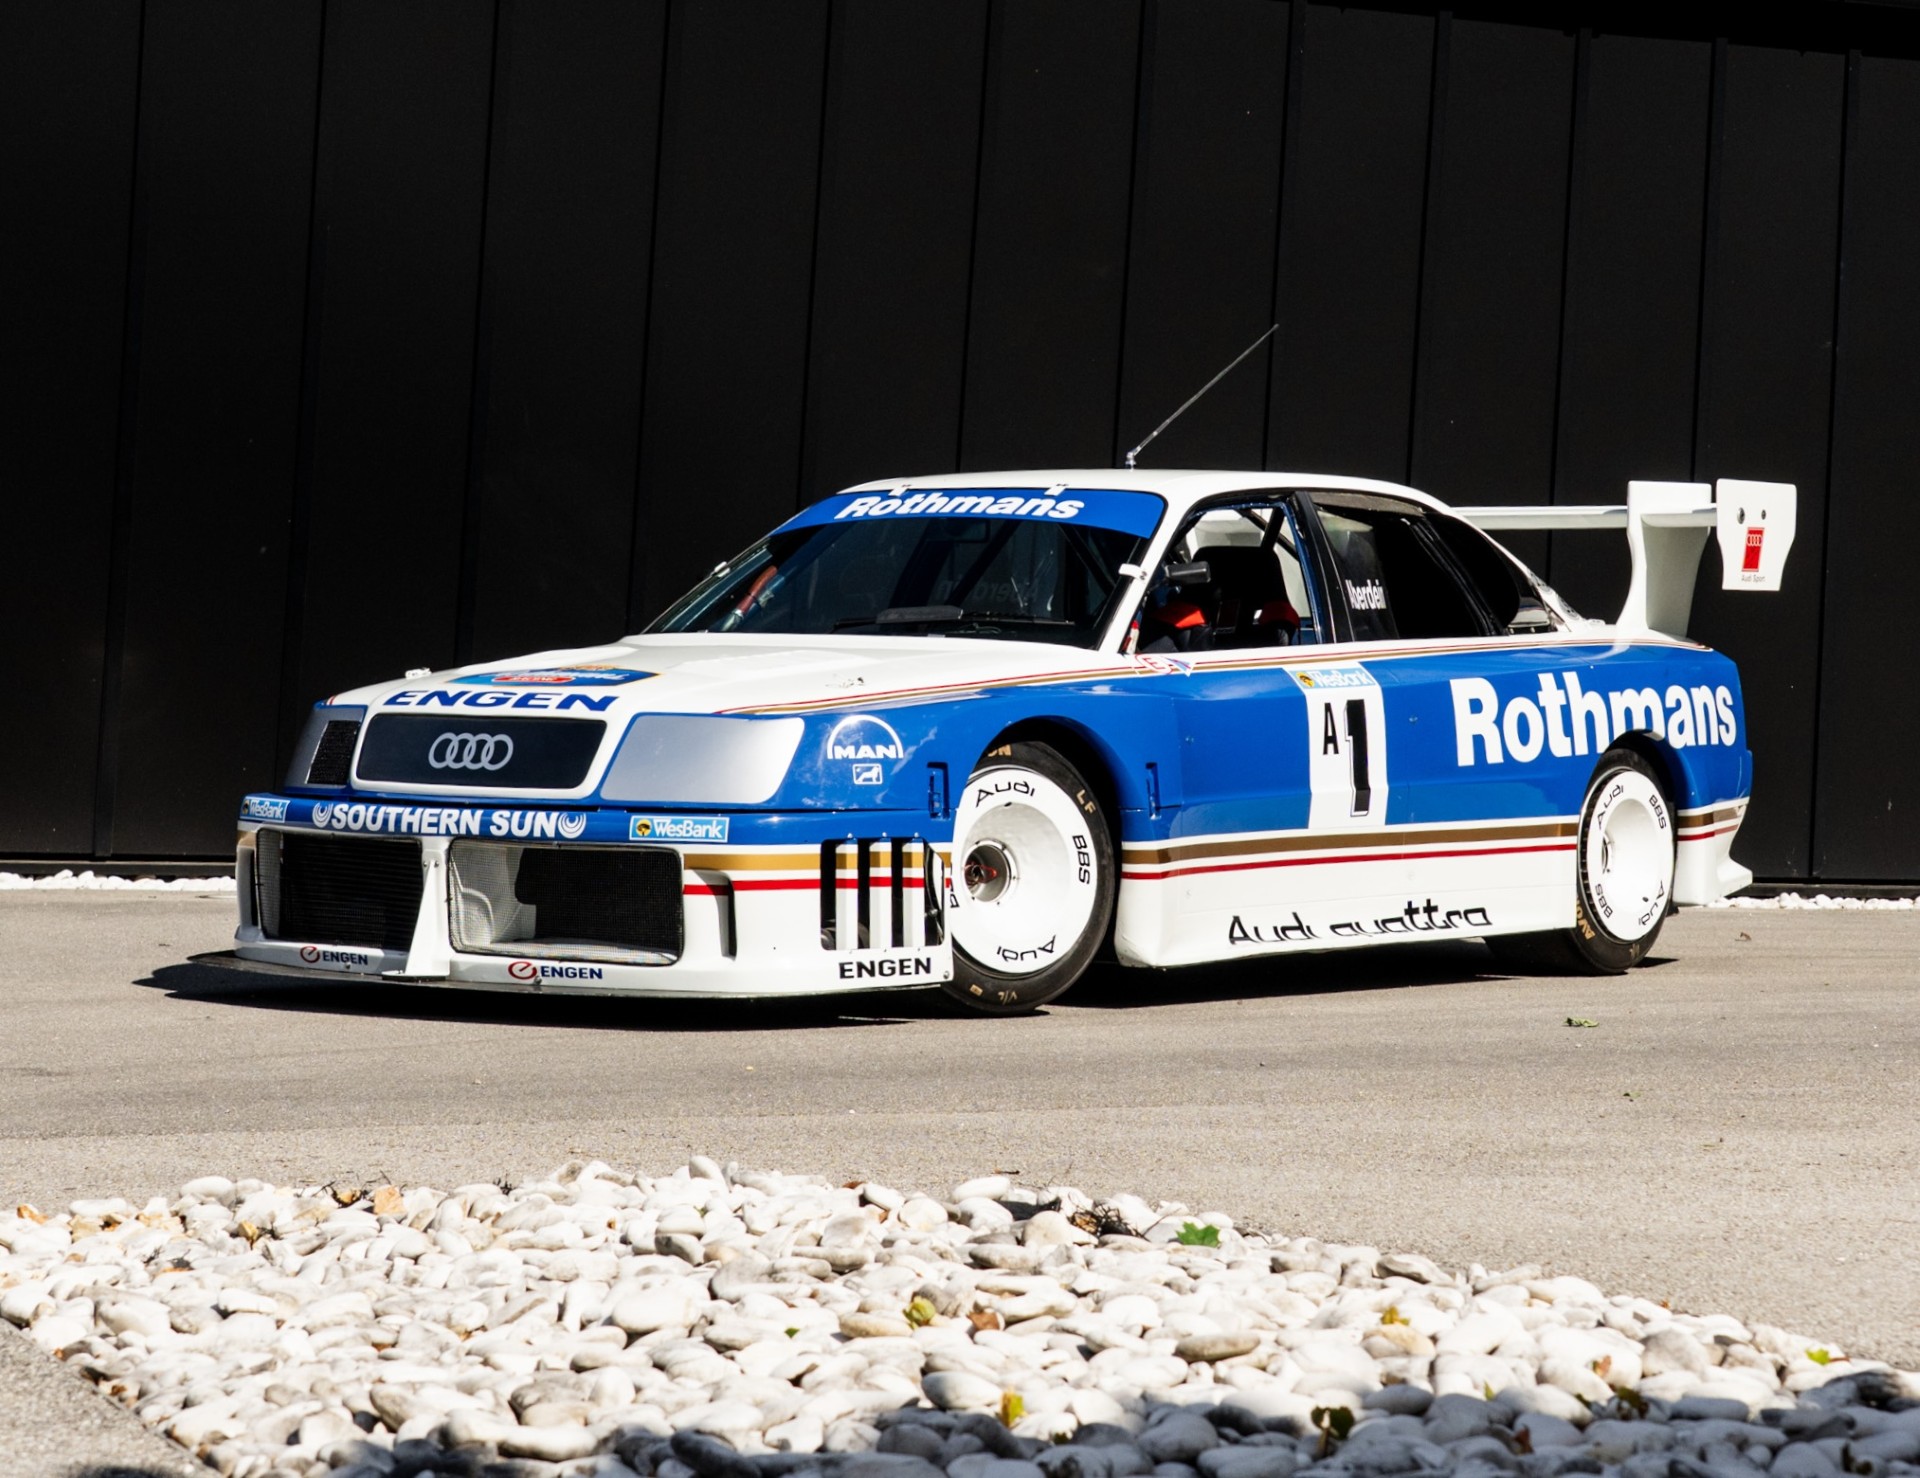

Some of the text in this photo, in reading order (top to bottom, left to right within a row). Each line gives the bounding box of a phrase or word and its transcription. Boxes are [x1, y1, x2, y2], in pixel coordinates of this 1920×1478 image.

[834, 492, 1085, 520] Rothmans
[1307, 669, 1373, 687] WesBank
[384, 689, 620, 712] ENGEN
[1450, 671, 1737, 767] Rothmans
[834, 744, 897, 760] MAN
[1322, 698, 1372, 817] A 1
[975, 780, 1035, 808] Audi
[1076, 789, 1097, 814] LF
[1597, 784, 1624, 830] Audi
[250, 799, 284, 819] WesBank
[329, 803, 560, 838] SOUTHERN SUN
[1649, 794, 1667, 830] BBS
[651, 816, 723, 840] WesBank
[1072, 834, 1091, 885] BBS
[1595, 883, 1613, 919] BBS
[1638, 879, 1665, 926] Audi
[1229, 898, 1493, 945] Audi quattro
[322, 950, 368, 965] ENGEN
[996, 934, 1056, 962] Audi
[540, 965, 603, 979] ENGEN
[838, 957, 932, 979] ENGEN
